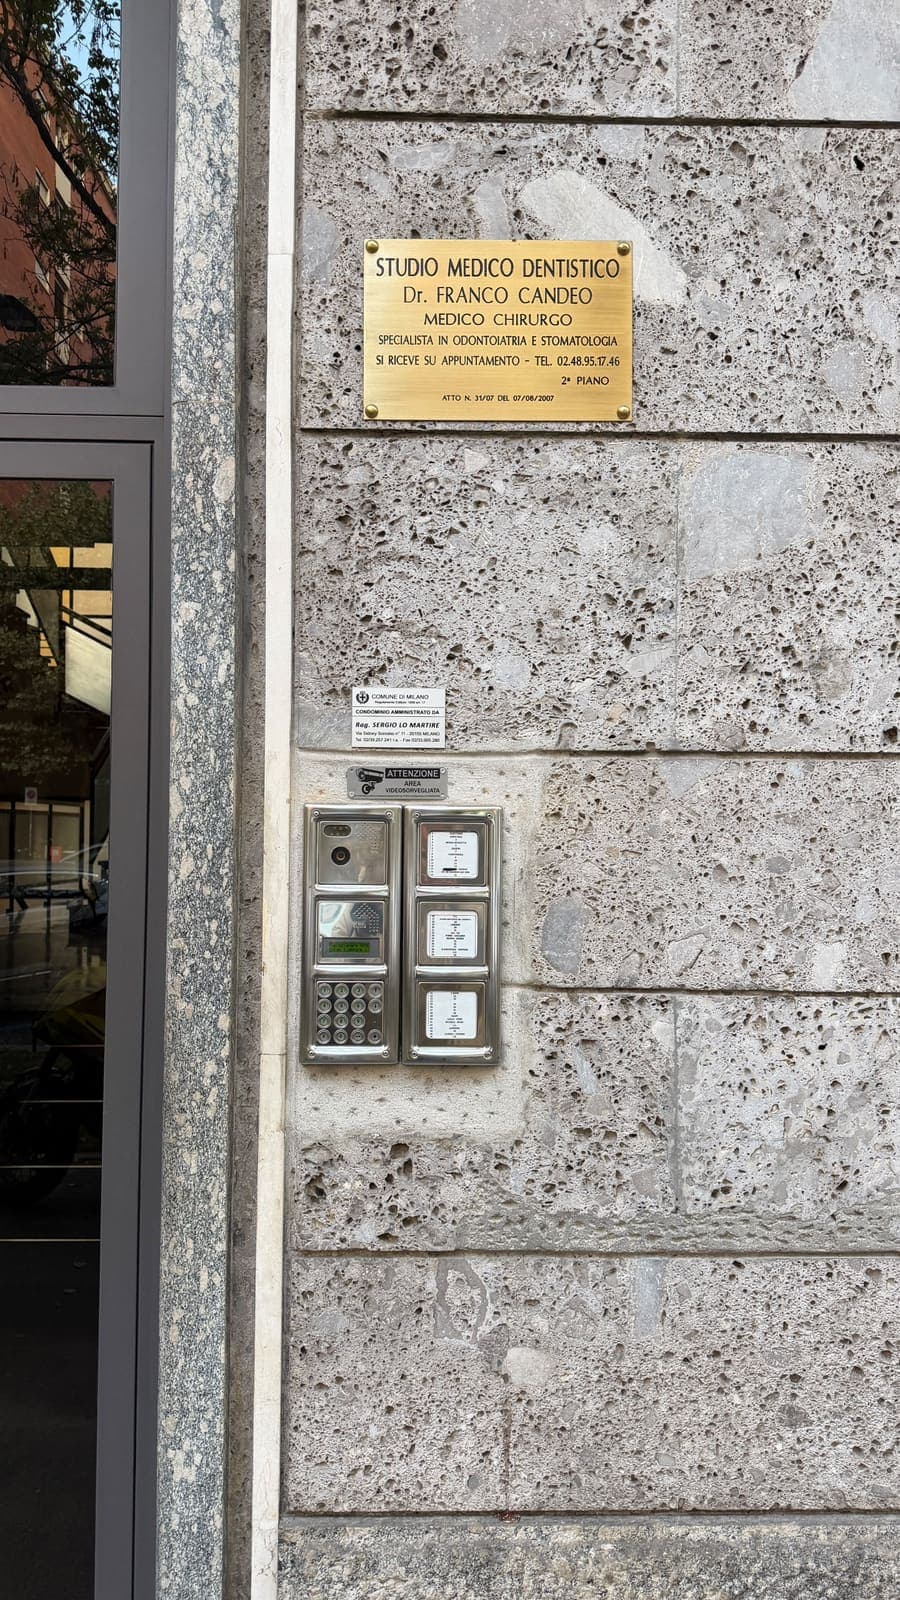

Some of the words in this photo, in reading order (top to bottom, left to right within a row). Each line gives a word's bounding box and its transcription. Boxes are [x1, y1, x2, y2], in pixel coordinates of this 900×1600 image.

[376, 257, 438, 277] STUDIO
[447, 258, 514, 277] MEDICO
[522, 258, 620, 279] DENTISTICO
[403, 286, 427, 304] Dr.
[437, 286, 509, 304] FRANCO
[518, 287, 593, 305] CANDEO
[423, 313, 485, 326] MEDICO
[493, 313, 573, 326] CHIRURGO
[378, 335, 434, 346] SPECIALISTA
[438, 335, 448, 346] IN
[453, 335, 527, 346] ODONTOIATRIA
[531, 336, 537, 346] E
[541, 335, 618, 347] STOMATOLOGIA
[376, 355, 384, 366] SI
[388, 355, 420, 366] RICEVE
[424, 355, 437, 366] SU
[441, 355, 520, 366] APPUNTAMENTO
[535, 356, 552, 366] TEL.
[557, 356, 620, 367] 02.48.95.17.46
[576, 376, 609, 386] PIANO
[387, 770, 439, 778] ATTENZIONE
